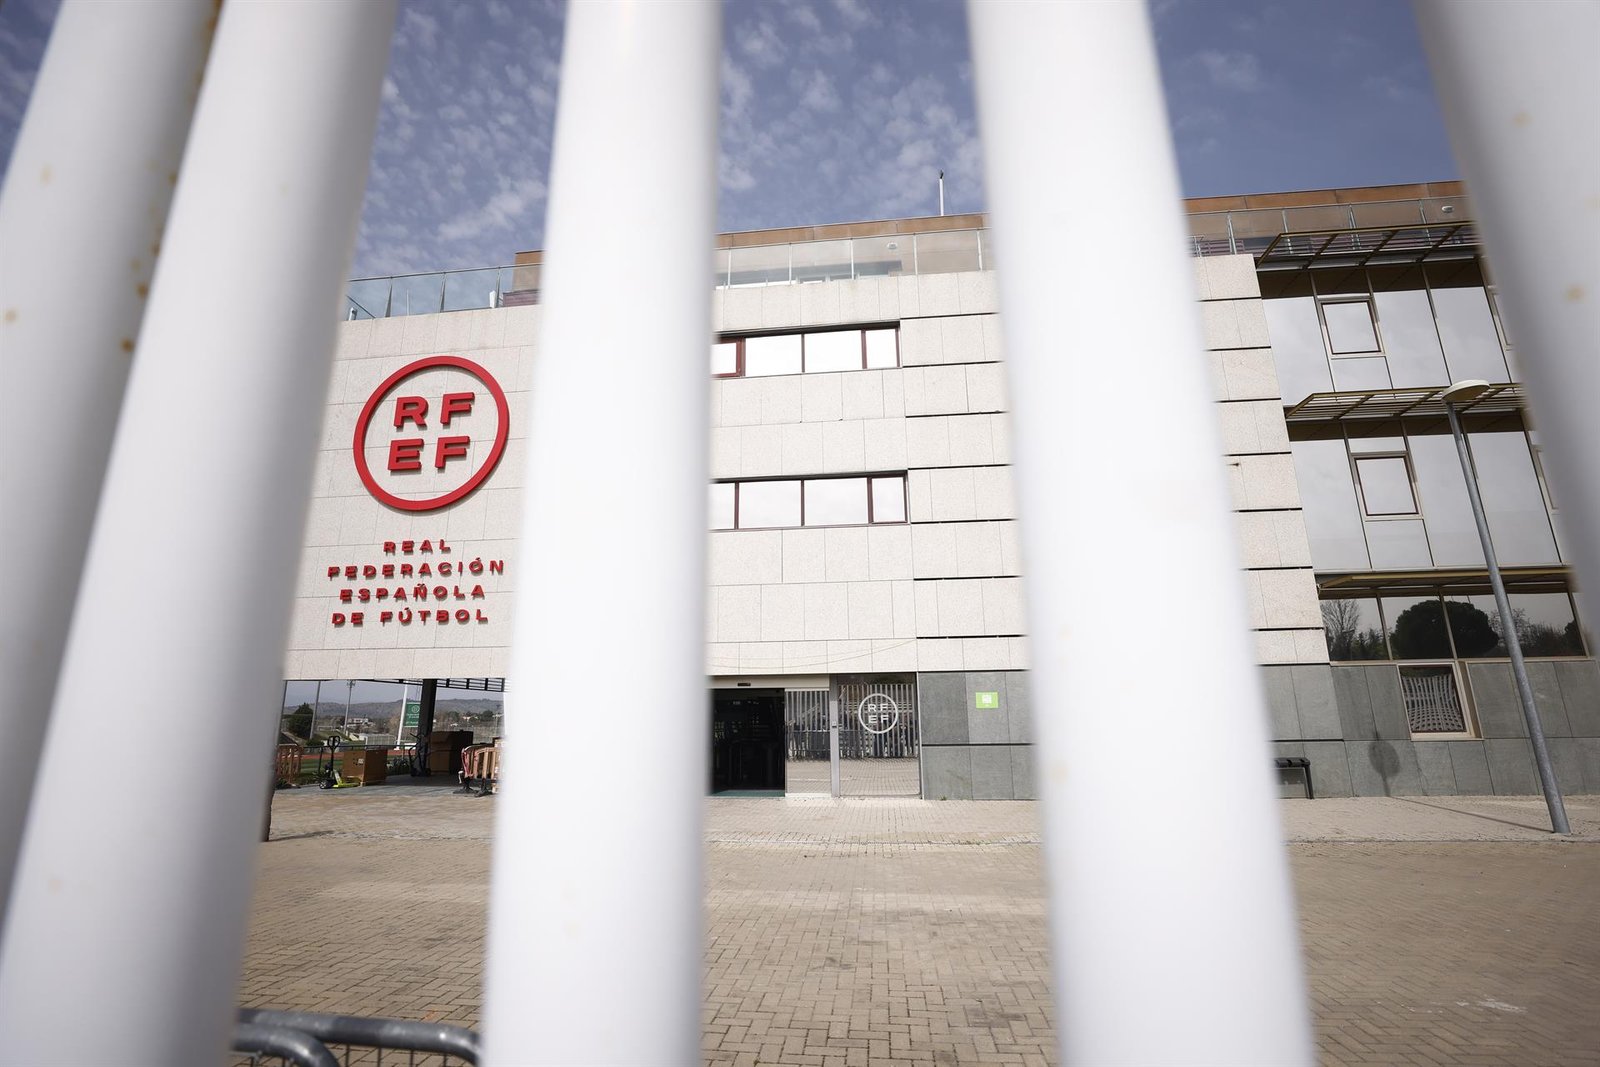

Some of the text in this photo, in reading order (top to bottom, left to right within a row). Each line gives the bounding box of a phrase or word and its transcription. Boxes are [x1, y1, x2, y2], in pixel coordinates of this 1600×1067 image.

[393, 391, 476, 429] RF
[387, 435, 471, 473] EF
[383, 539, 450, 554] REAL
[327, 557, 504, 579] FEDERACIÓN
[339, 583, 485, 601] ESPAÑOLA
[331, 607, 488, 626] DE FÚTBOL
[868, 703, 888, 712] RF
[868, 714, 889, 723] EF
